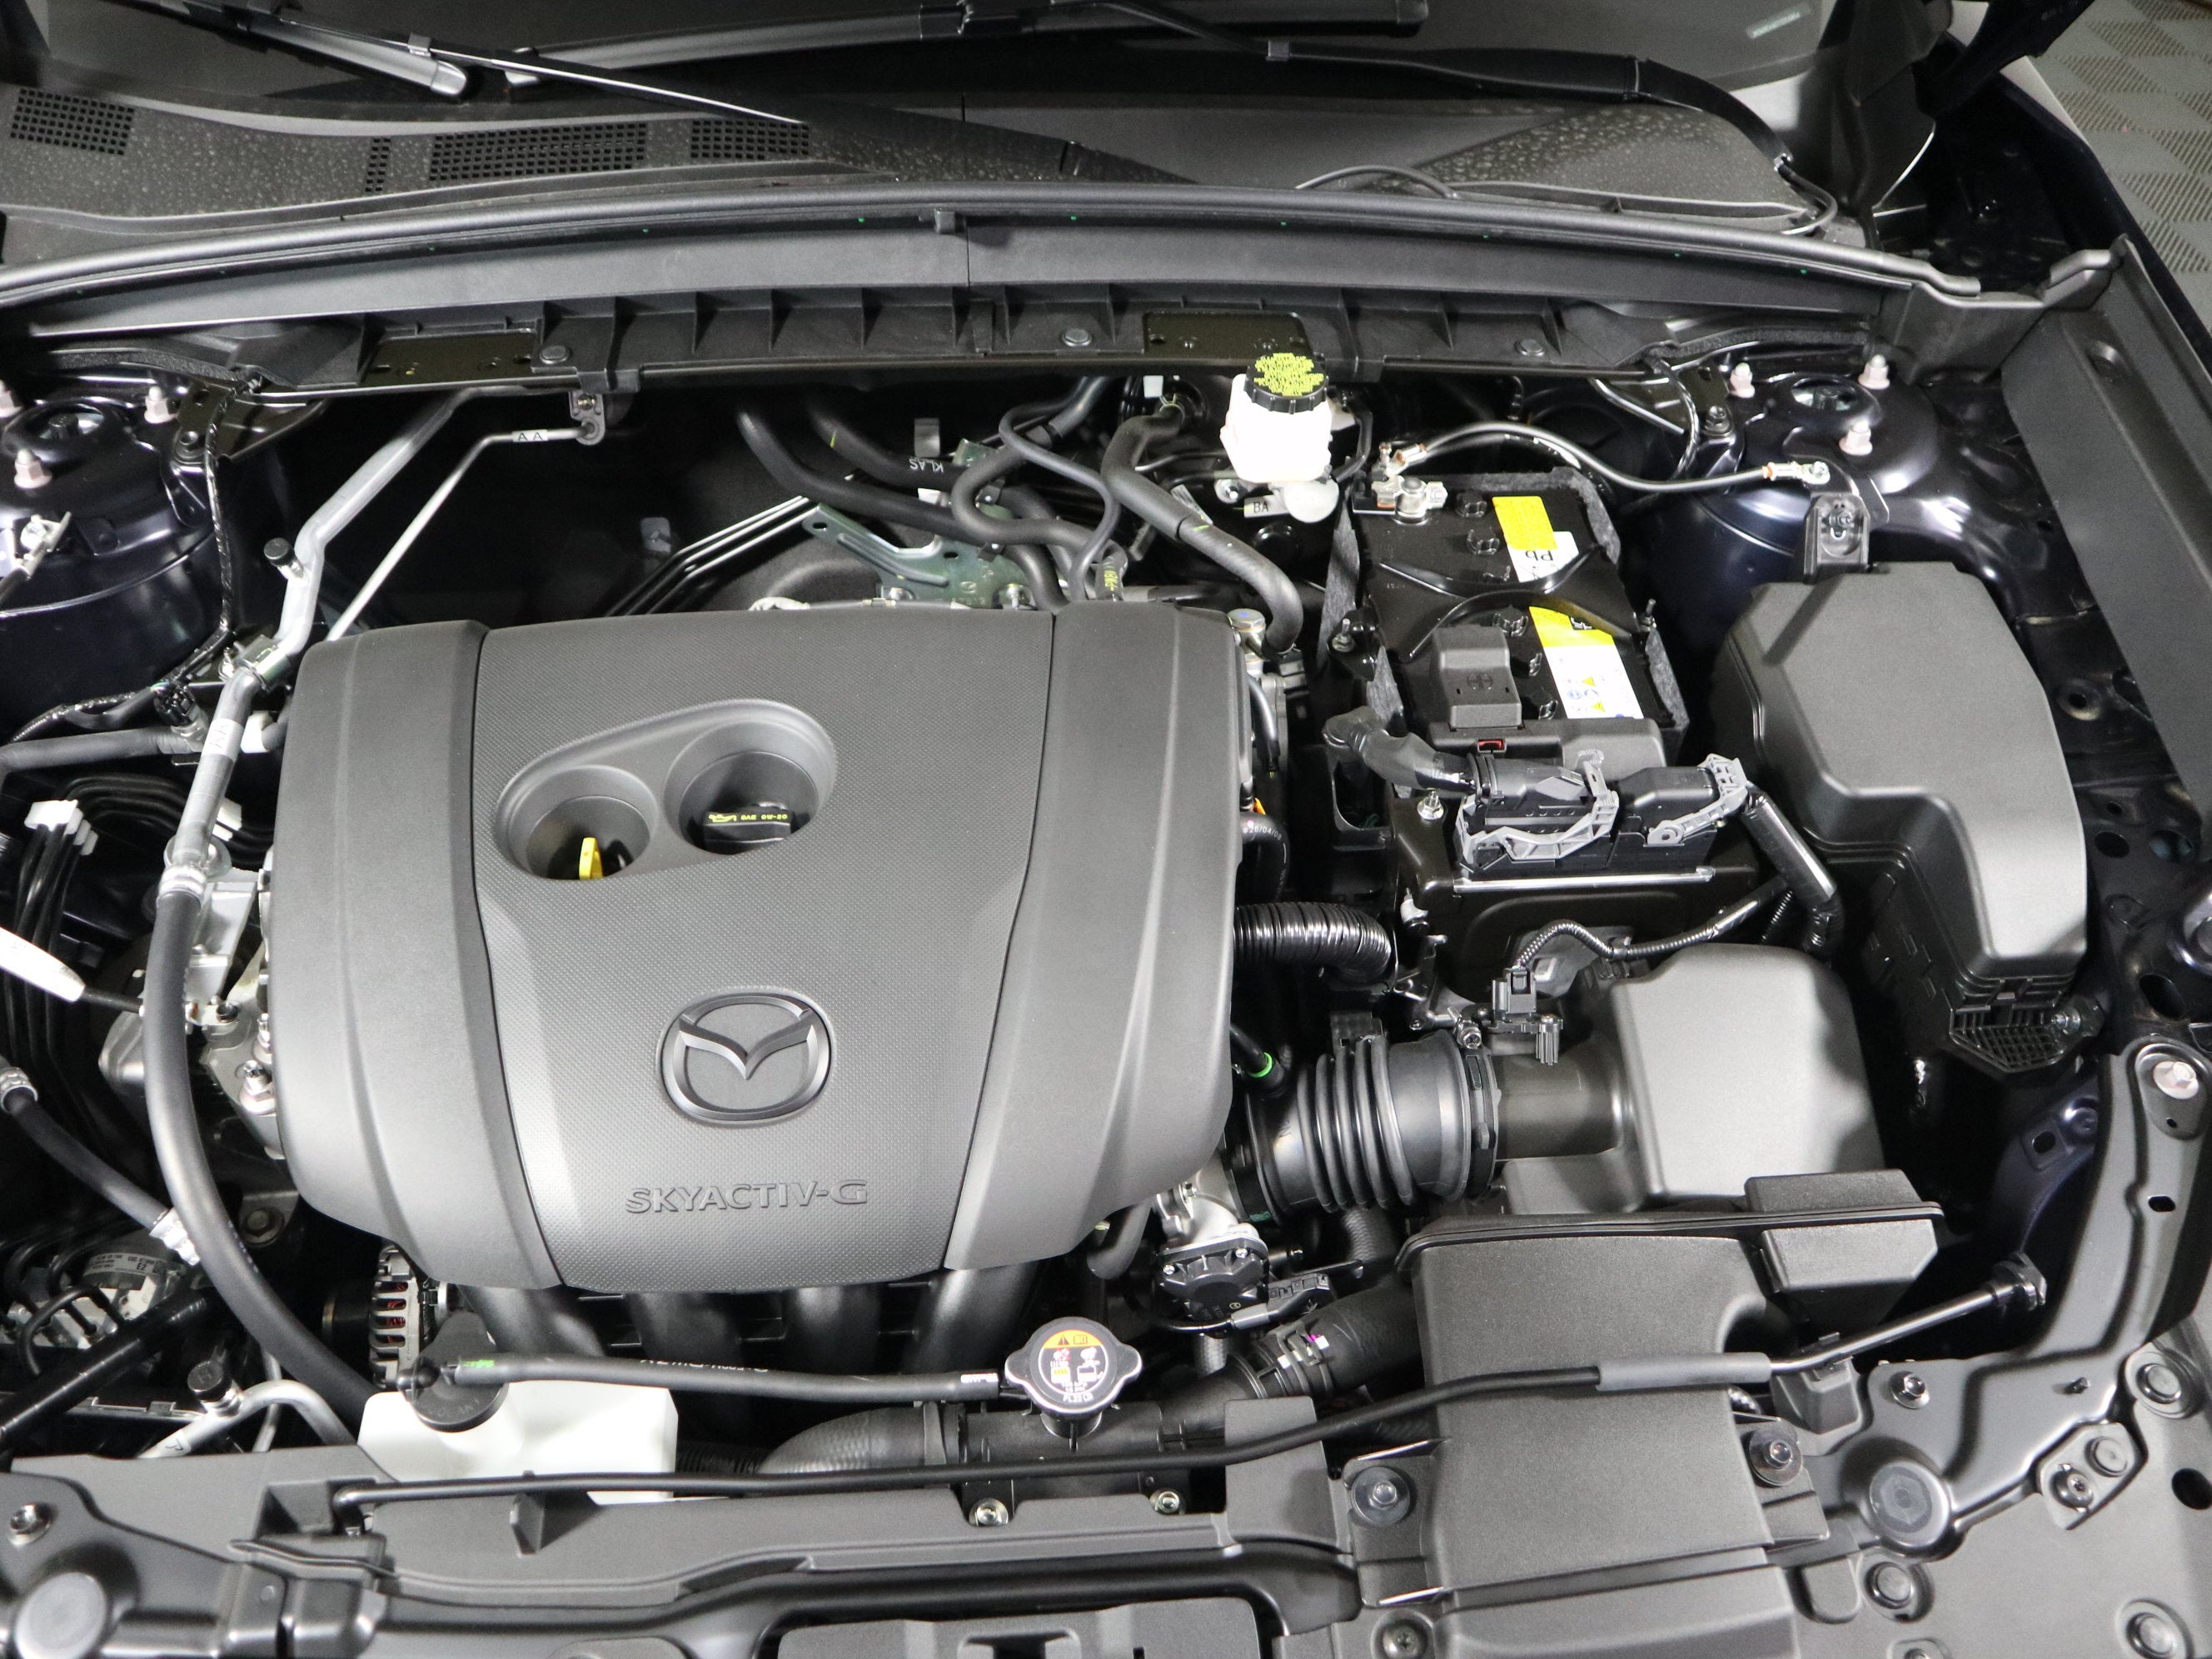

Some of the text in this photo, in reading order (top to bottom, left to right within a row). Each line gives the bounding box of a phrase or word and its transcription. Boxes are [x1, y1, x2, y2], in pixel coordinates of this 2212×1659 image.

[1253, 501, 1269, 514] BA
[760, 813, 788, 821] 0W-20
[625, 1178, 868, 1214] SKYACTIV-G
